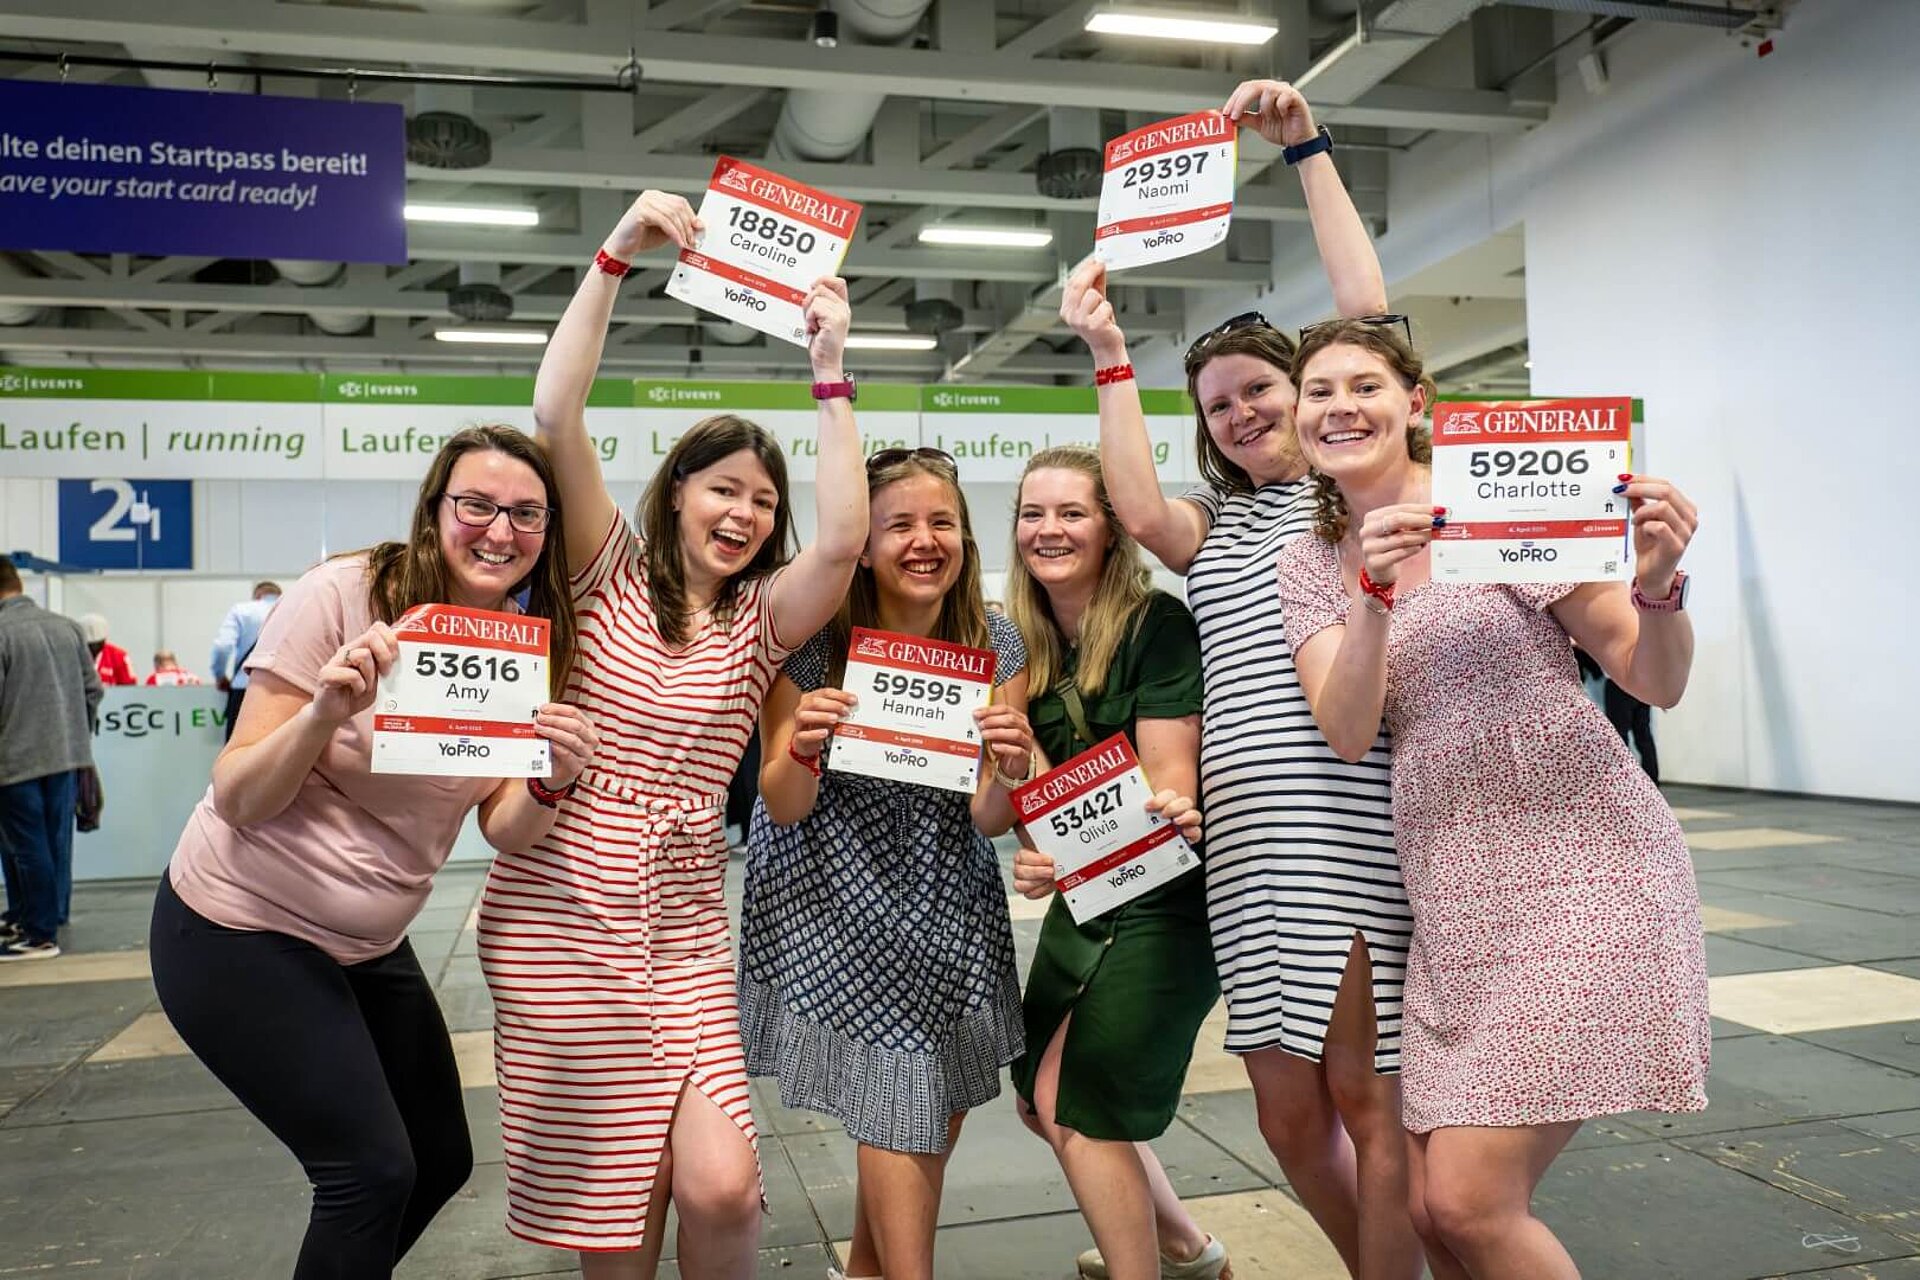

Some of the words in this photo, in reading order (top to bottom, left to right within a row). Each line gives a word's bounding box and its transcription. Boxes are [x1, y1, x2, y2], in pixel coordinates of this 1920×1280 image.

[1134, 116, 1226, 152] GENERALI
[0, 132, 38, 158] lte
[46, 136, 142, 164] deinen
[150, 142, 276, 173] Startpass
[282, 149, 367, 176] bereit!
[1122, 151, 1209, 189] 29397
[50, 177, 110, 199] your
[114, 177, 173, 200] start
[179, 177, 235, 202] card
[239, 184, 318, 211] ready!
[750, 177, 850, 230] GENERALI
[1138, 180, 1189, 199] Naomi
[729, 206, 815, 255] 18850
[1142, 232, 1184, 249] YoPRO
[730, 233, 798, 268] Caroline
[724, 287, 767, 311] YoPRO
[31, 379, 84, 390] EVENTS
[1483, 408, 1618, 434] GENERALI
[0, 422, 125, 451] Laufen
[168, 425, 305, 460] running
[1469, 449, 1589, 478] 59206
[1477, 481, 1582, 499] Charlotte
[1499, 548, 1557, 563] YoPRO
[431, 613, 541, 647] GENERALI
[415, 651, 520, 683] 53616
[889, 641, 987, 675] GENERALI
[445, 683, 490, 704] Amy
[872, 671, 962, 706] 59595
[105, 705, 164, 736] SCC
[883, 698, 945, 721] Hannah
[438, 742, 491, 758] YoPRO
[884, 751, 928, 768] YoPRO
[1043, 744, 1128, 801] GENERALI
[1050, 783, 1124, 837] 53427
[1079, 817, 1119, 844] Olivia
[1108, 864, 1146, 889] YoPRO
